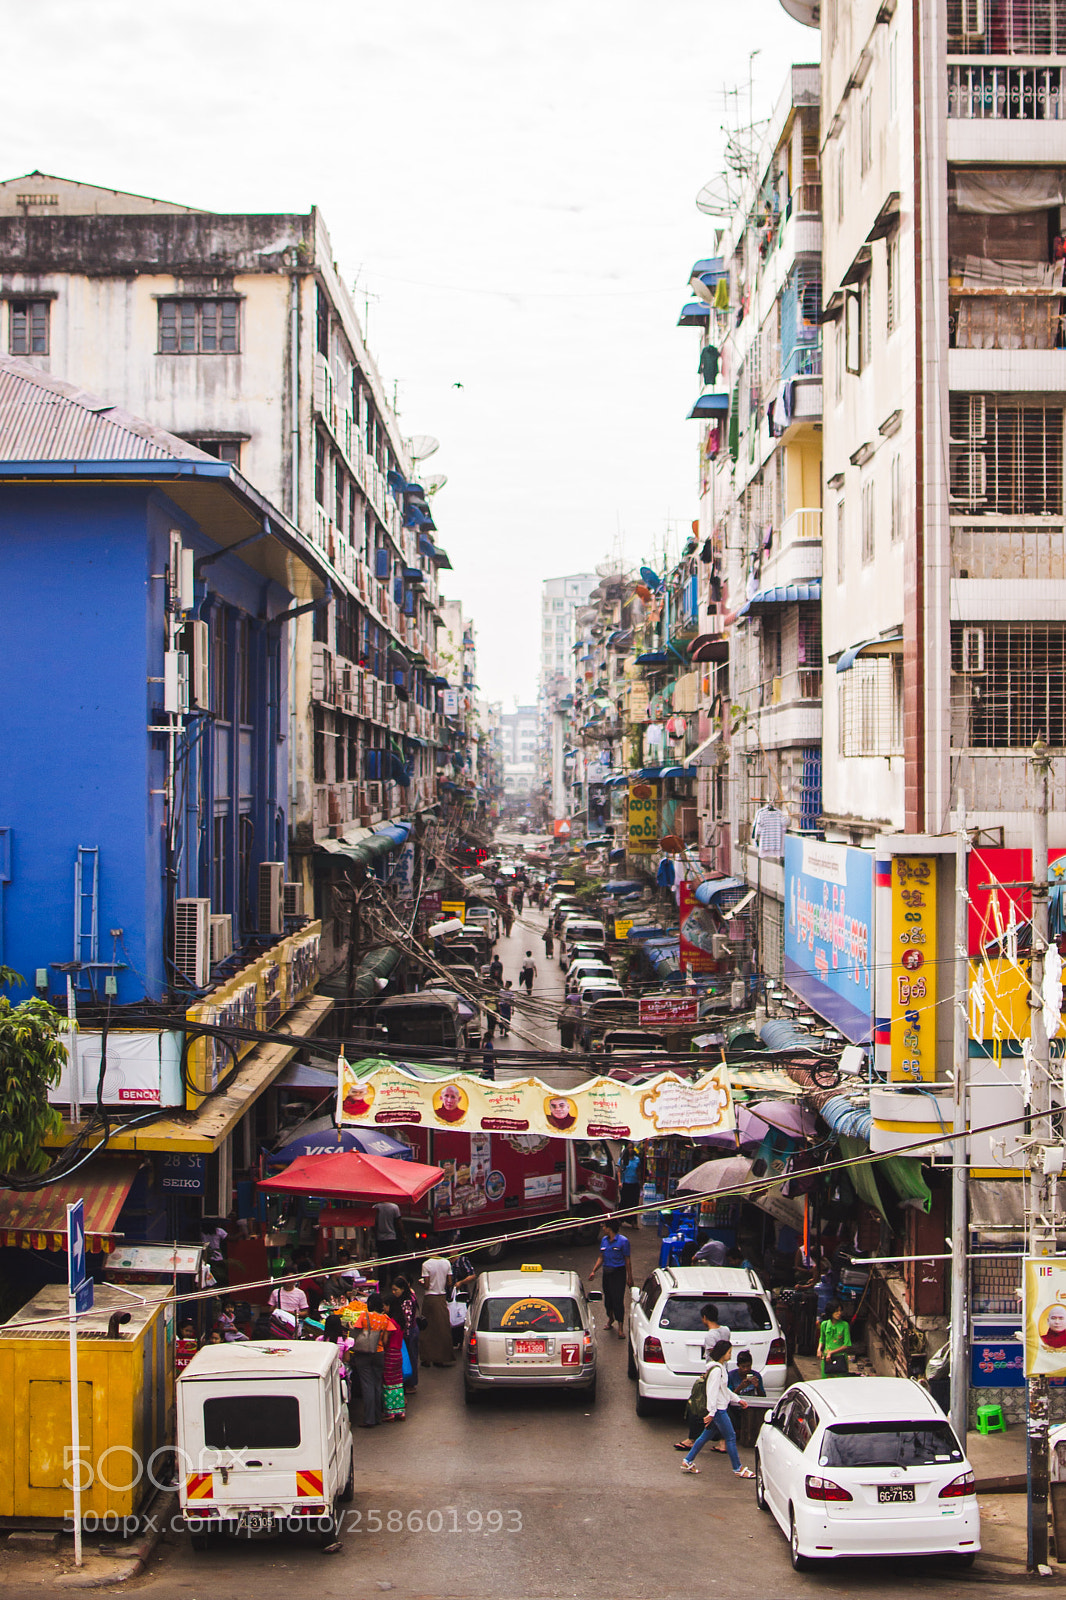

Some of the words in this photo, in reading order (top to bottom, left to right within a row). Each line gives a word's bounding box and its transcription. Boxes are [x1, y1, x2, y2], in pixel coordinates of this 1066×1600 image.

[164, 1154, 181, 1167] 28
[162, 1178, 201, 1188] SEIKO
[565, 1349, 575, 1362] 7
